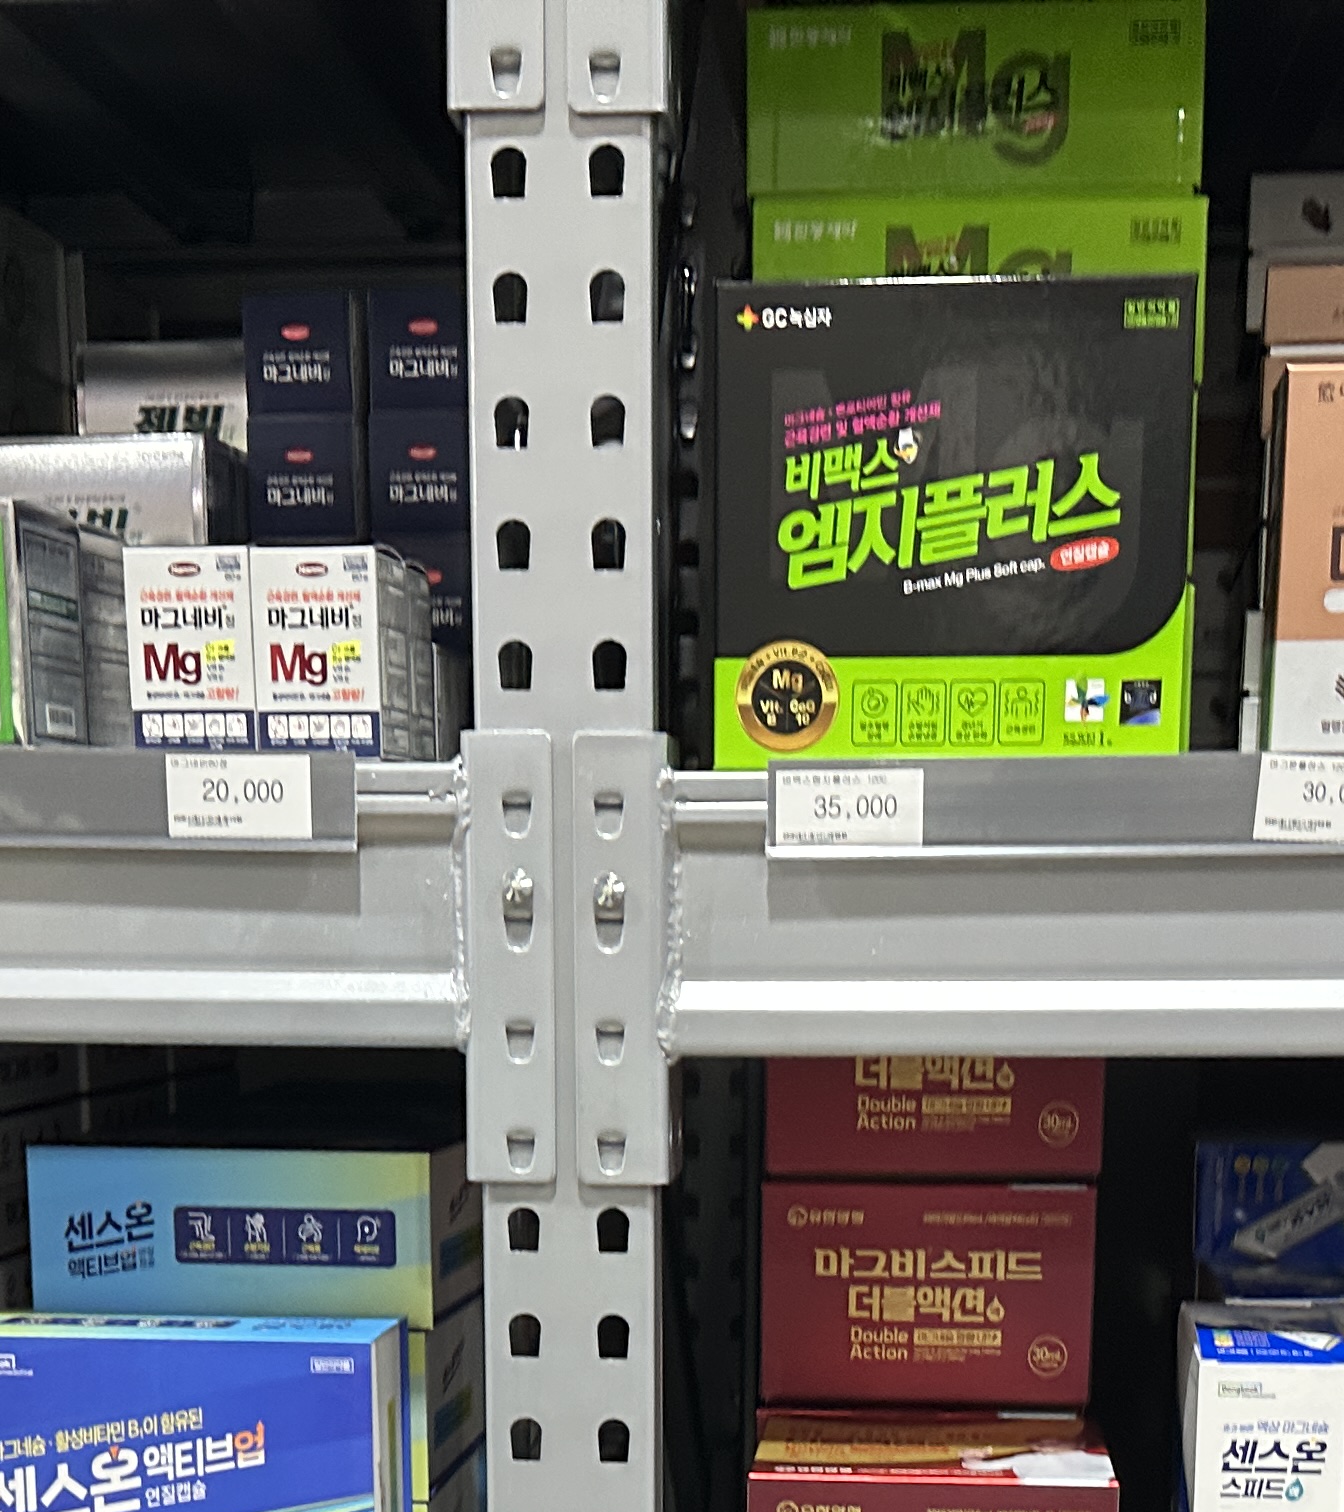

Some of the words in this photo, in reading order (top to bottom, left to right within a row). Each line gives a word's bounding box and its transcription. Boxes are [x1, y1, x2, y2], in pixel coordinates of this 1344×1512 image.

[785, 438, 900, 499] 비맥스
[778, 452, 1122, 590] 엠지플러스
[141, 643, 202, 685] Mg
[268, 643, 330, 685] Mg
[771, 668, 804, 692] Mg
[200, 777, 285, 804] 20,000
[813, 794, 899, 821] 35,000
[856, 1115, 917, 1132] Action
[64, 1201, 155, 1254] 센스온
[813, 1247, 1045, 1283] 마그비스피드
[850, 1326, 909, 1345] Double
[849, 1345, 909, 1362] Action
[142, 1420, 266, 1483] 액티브업
[1221, 1436, 1328, 1477] 센스온
[144, 1479, 207, 1508] 연질캡슐
[1219, 1477, 1286, 1500] 스피드
